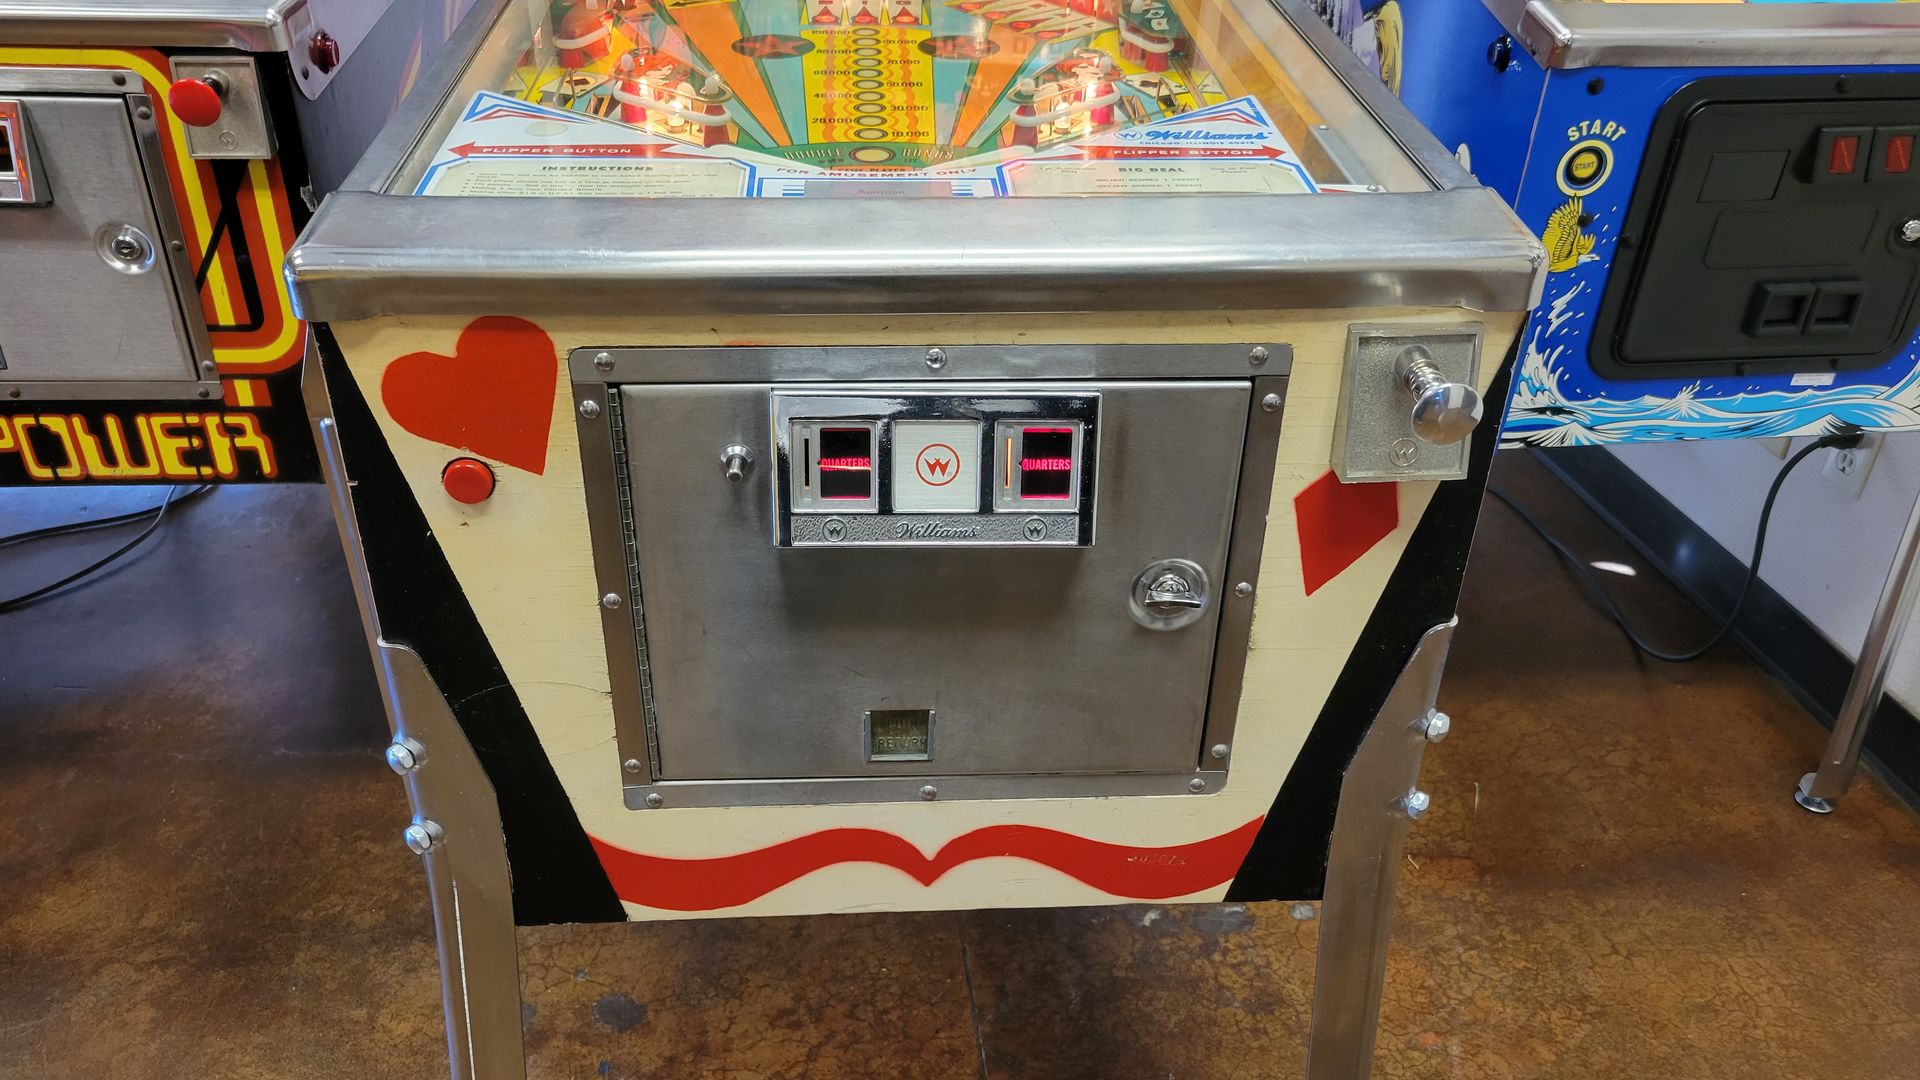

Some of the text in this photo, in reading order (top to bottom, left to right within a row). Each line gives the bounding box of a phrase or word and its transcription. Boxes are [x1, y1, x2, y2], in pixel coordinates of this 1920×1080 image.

[1145, 130, 1269, 141] Williams
[1567, 119, 1626, 141] START
[902, 148, 954, 159] BONUS
[936, 168, 977, 176] ONLY
[1574, 161, 1595, 172] START
[0, 413, 278, 480] OWER
[821, 457, 870, 470] QUARTERS
[1020, 457, 1072, 471] QUARTERS
[895, 521, 979, 539] Williams
